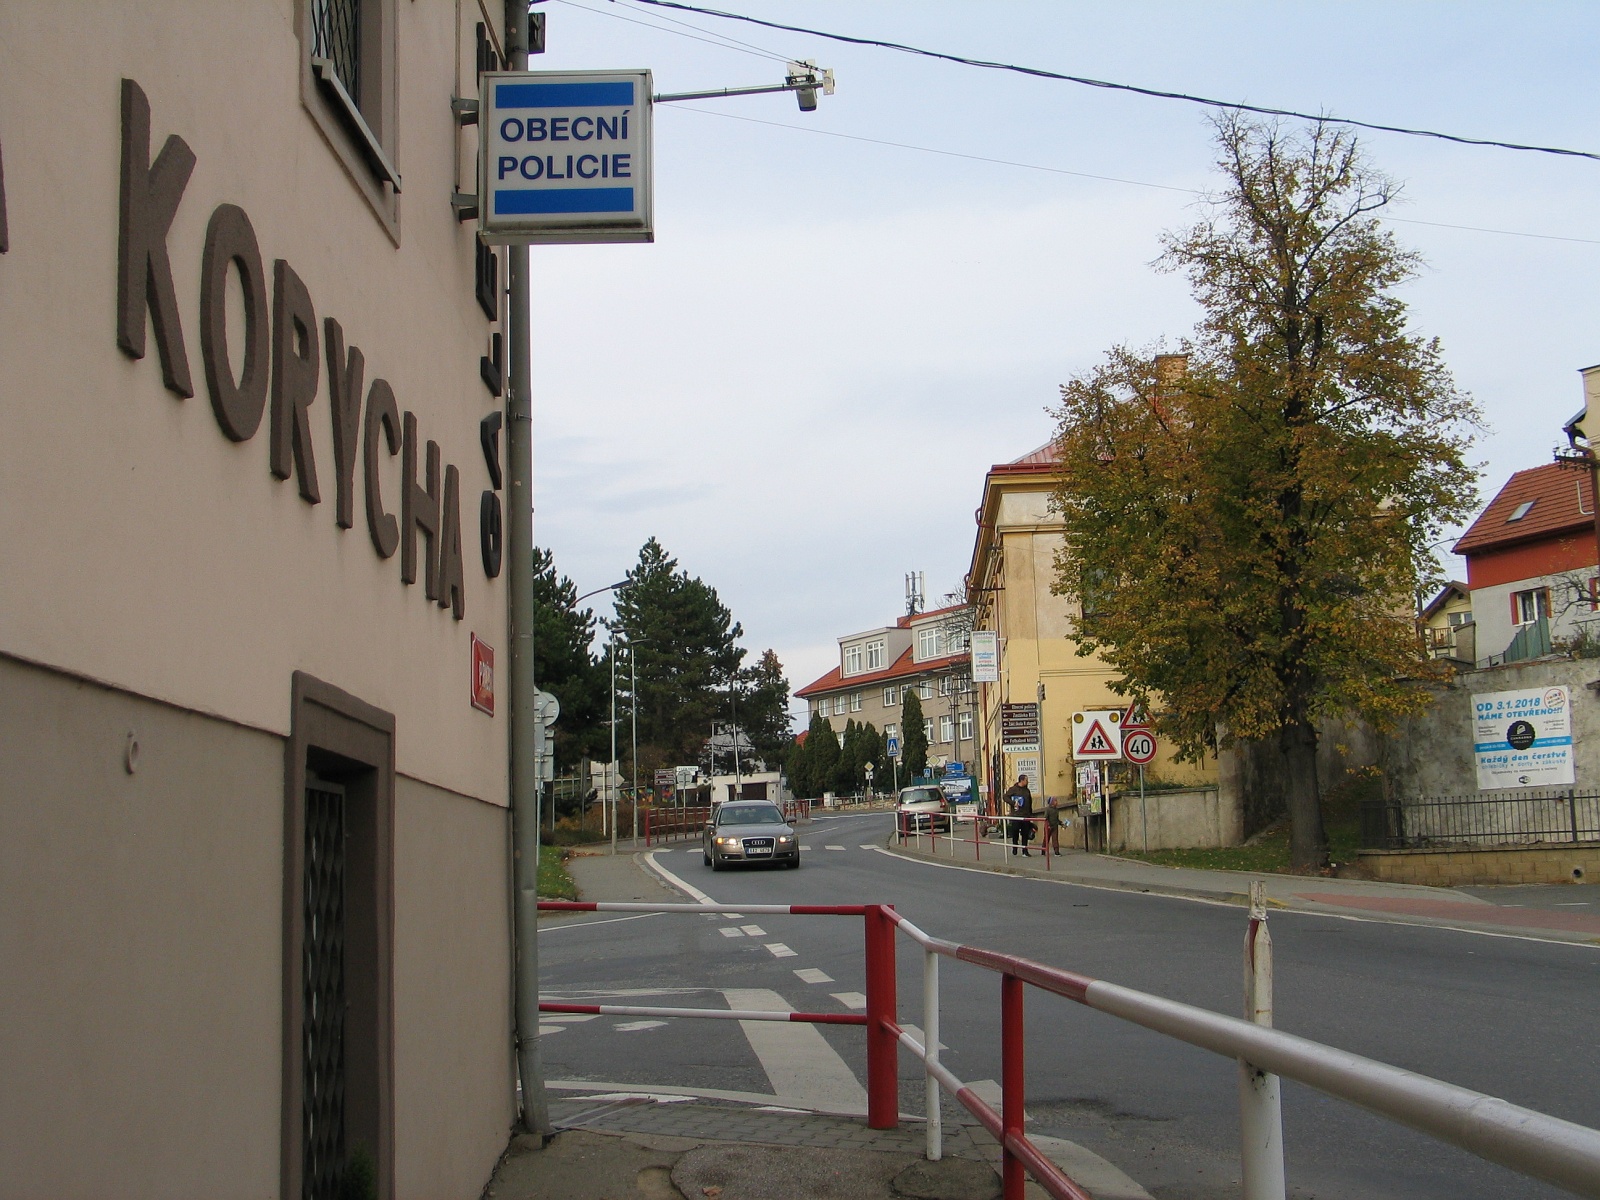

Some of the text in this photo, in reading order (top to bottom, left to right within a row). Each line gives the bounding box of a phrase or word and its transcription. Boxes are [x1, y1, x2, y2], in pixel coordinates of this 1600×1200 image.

[500, 110, 630, 142] OBECNÍ
[498, 154, 631, 180] POLICIE
[117, 77, 465, 620] KORYCHA
[1476, 702, 1493, 712] OD
[1478, 711, 1503, 721] MÁME
[1130, 739, 1150, 755] 40
[1480, 754, 1508, 764] Každý
[1532, 750, 1567, 760] čerstvé
